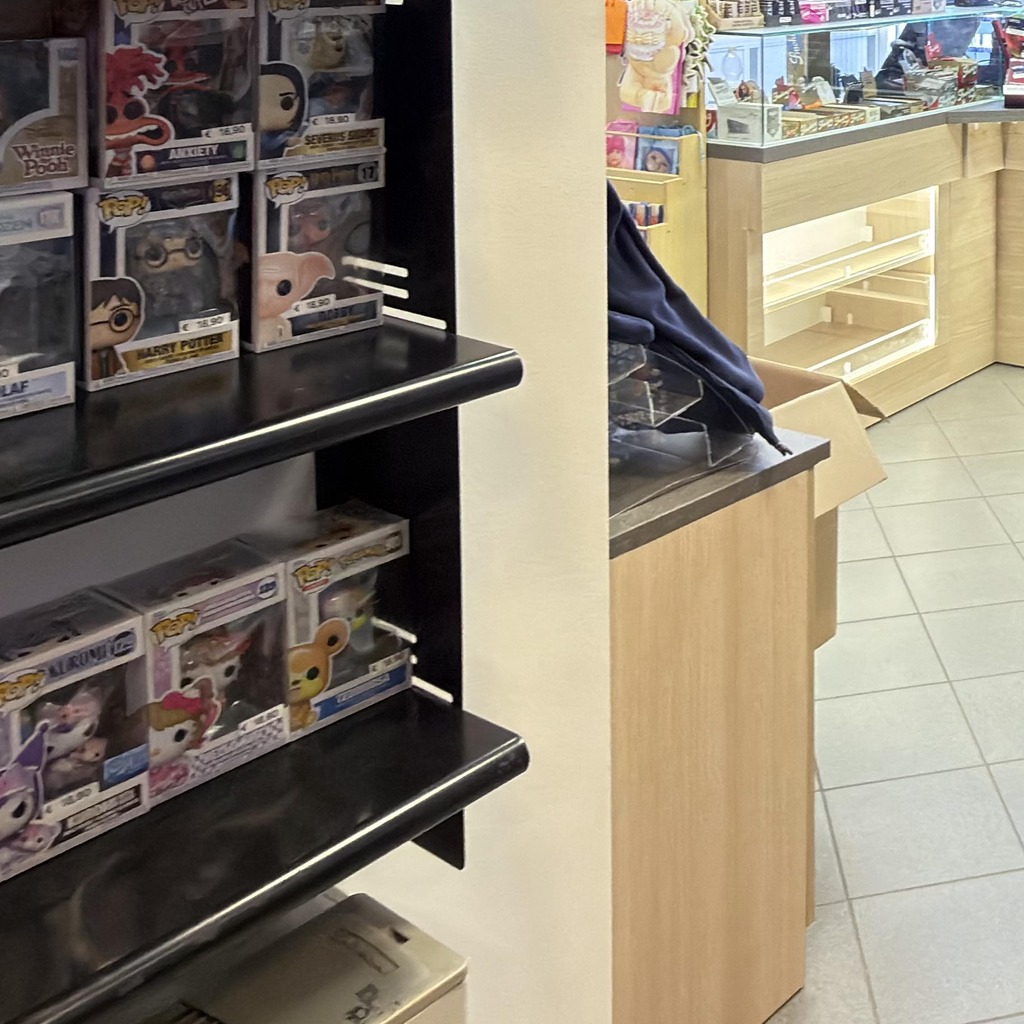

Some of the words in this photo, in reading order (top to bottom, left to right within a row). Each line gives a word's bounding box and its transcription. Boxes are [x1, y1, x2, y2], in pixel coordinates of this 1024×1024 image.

[11, 141, 75, 160] Winnie
[23, 157, 69, 177] Pooh
[265, 174, 307, 199] POP!
[96, 193, 149, 222] POP!
